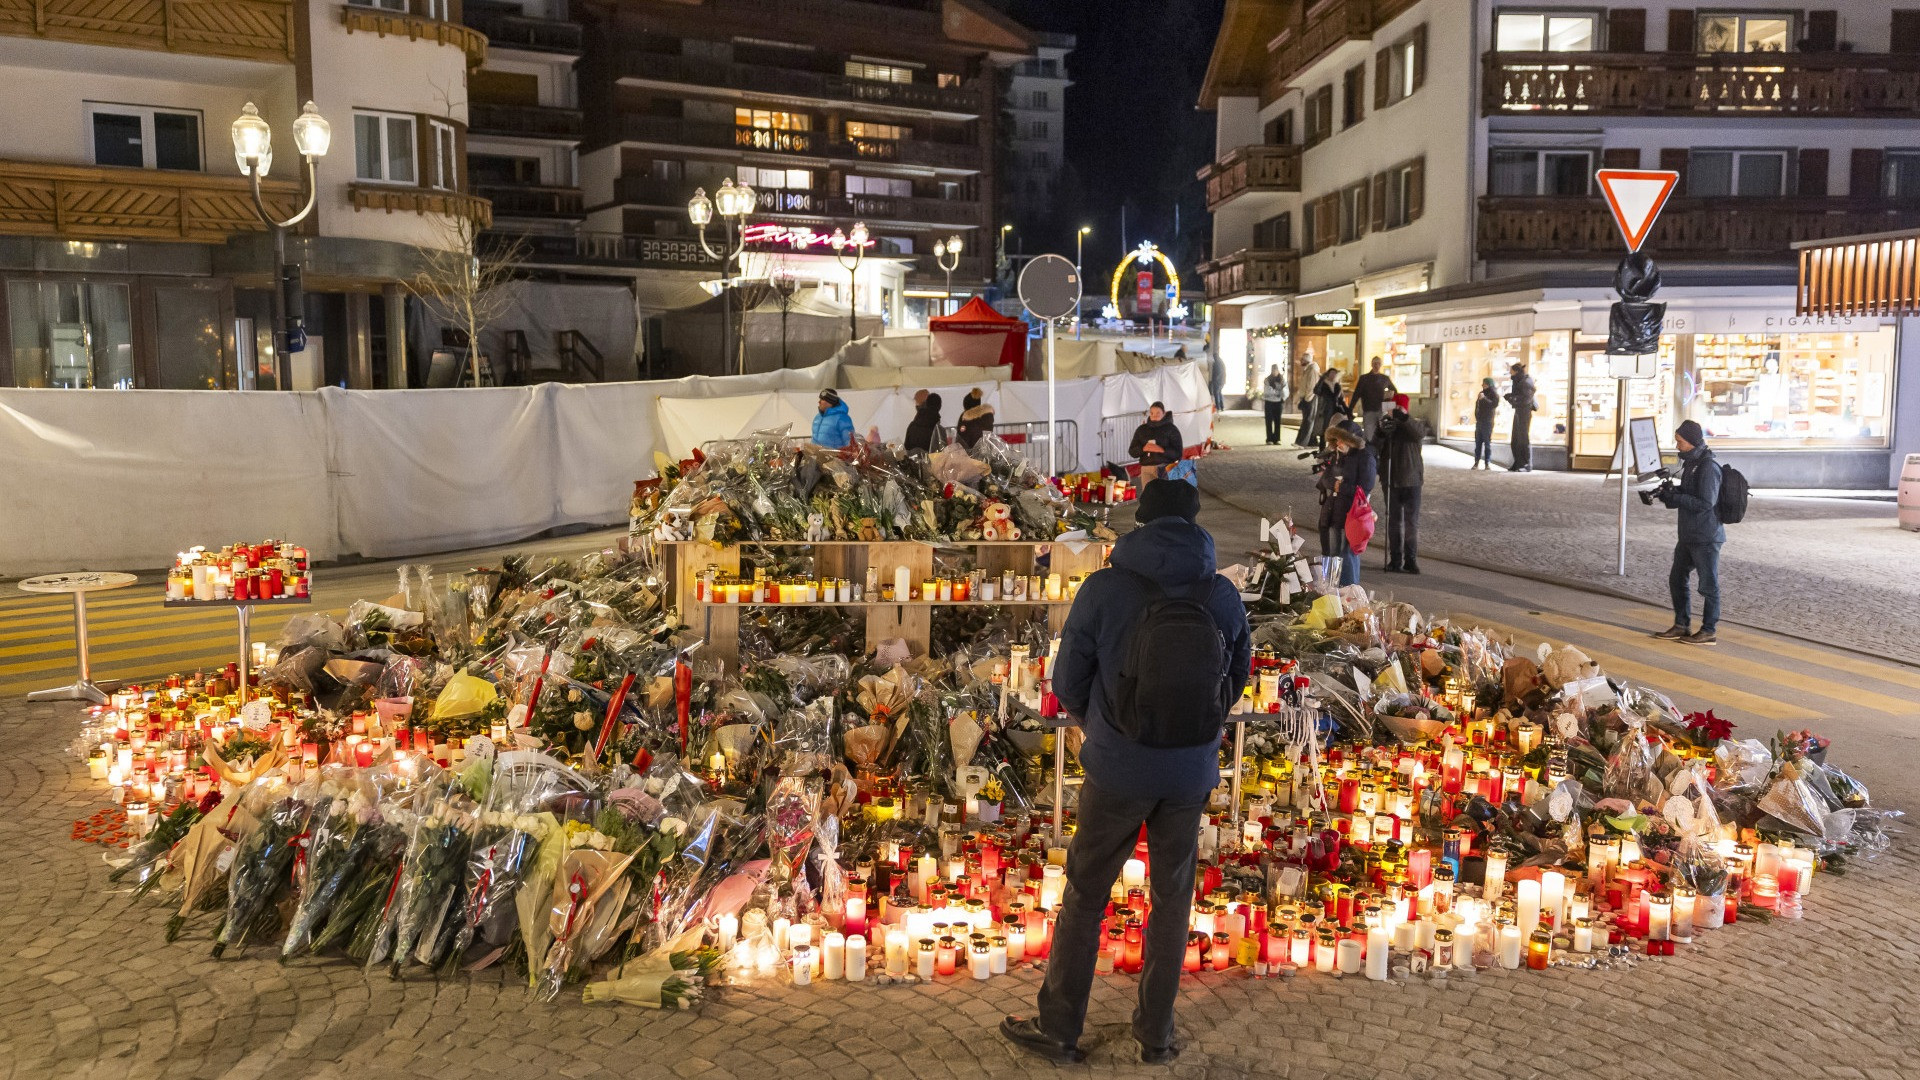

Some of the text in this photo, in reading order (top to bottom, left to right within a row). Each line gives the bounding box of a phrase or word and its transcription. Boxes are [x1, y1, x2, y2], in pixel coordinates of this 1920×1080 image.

[1665, 316, 1686, 329] rie
[1765, 317, 1852, 326] CIGARES
[1443, 324, 1487, 337] CIGARES
